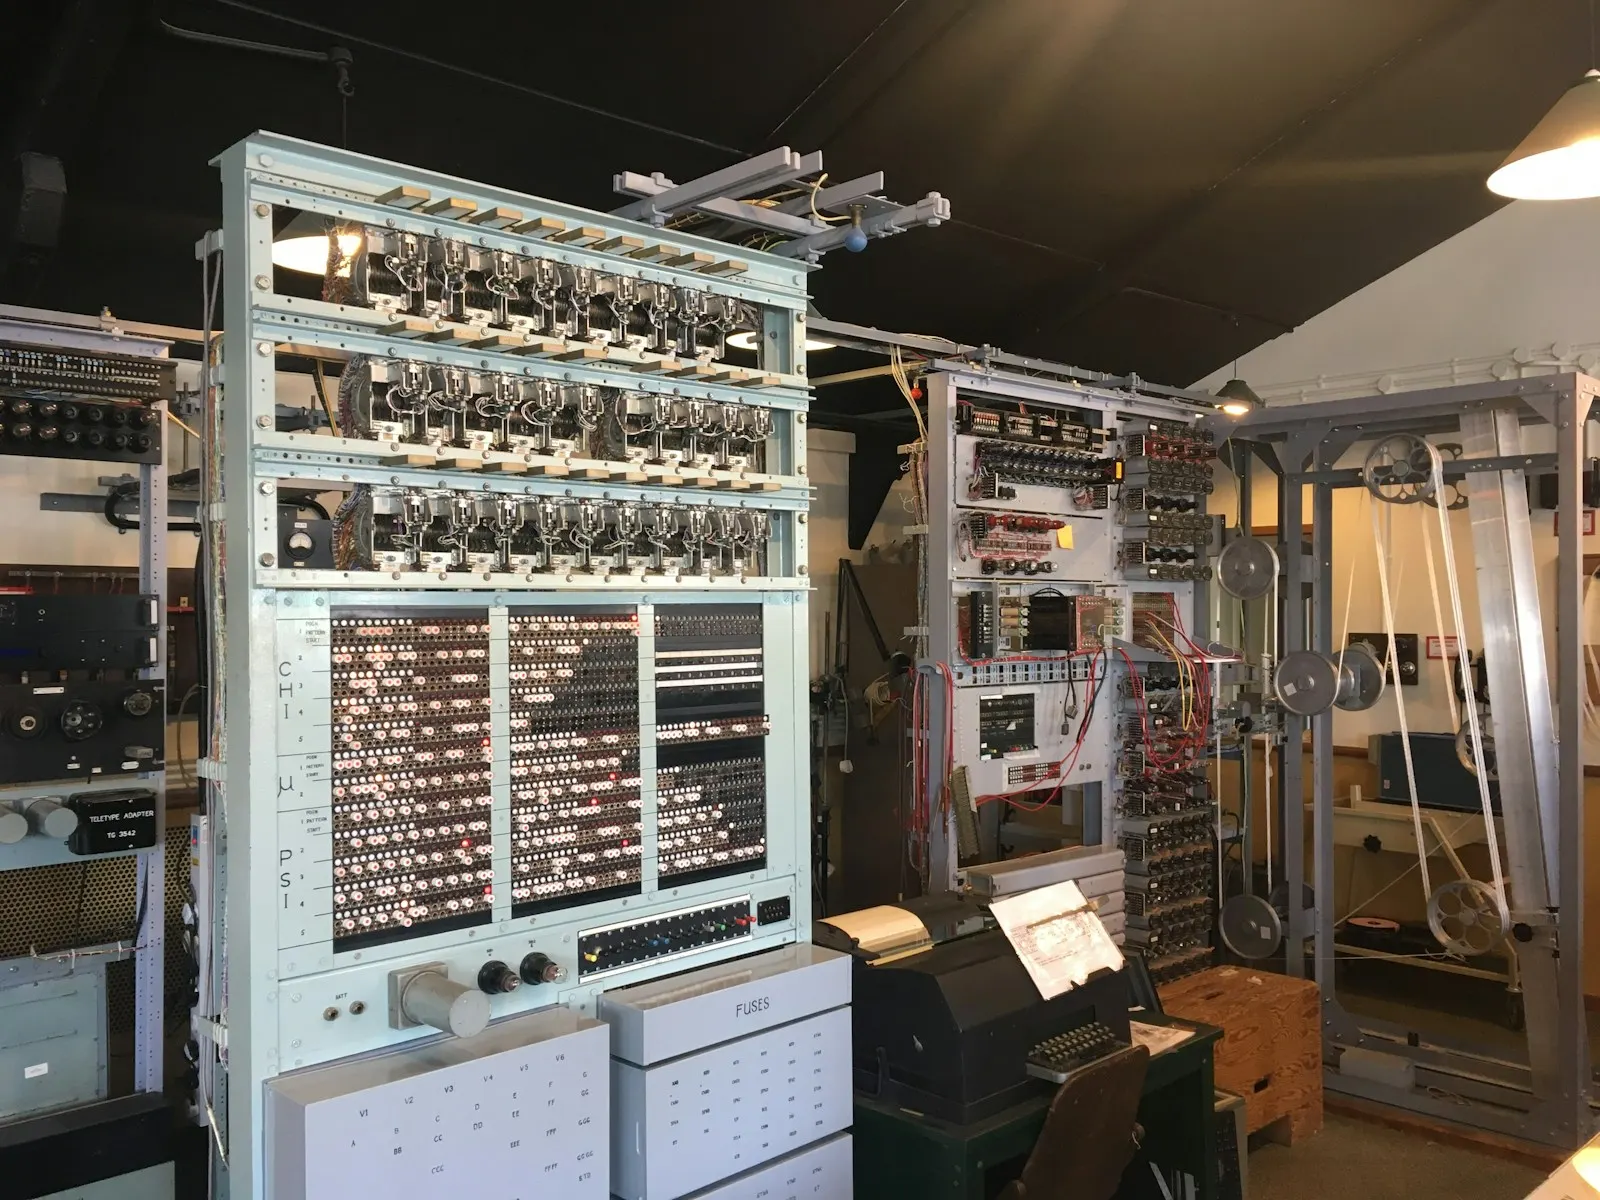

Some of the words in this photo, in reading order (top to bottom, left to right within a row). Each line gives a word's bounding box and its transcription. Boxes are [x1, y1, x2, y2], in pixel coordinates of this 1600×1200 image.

[89, 813, 120, 823] TELETYPE
[123, 810, 154, 819] ADAPTER
[118, 830, 136, 838] 3542
[335, 992, 348, 1000] BATT
[736, 997, 770, 1018] FUSES
[555, 1054, 565, 1062] V6
[520, 1064, 529, 1072] V5
[444, 1085, 454, 1094] V3
[404, 1096, 414, 1105] V2
[359, 1109, 369, 1118] V1
[512, 1110, 520, 1118] EE
[435, 1115, 441, 1123] C
[433, 1134, 443, 1143] CC
[393, 1147, 402, 1155] BB
[431, 1164, 445, 1174] CCC
